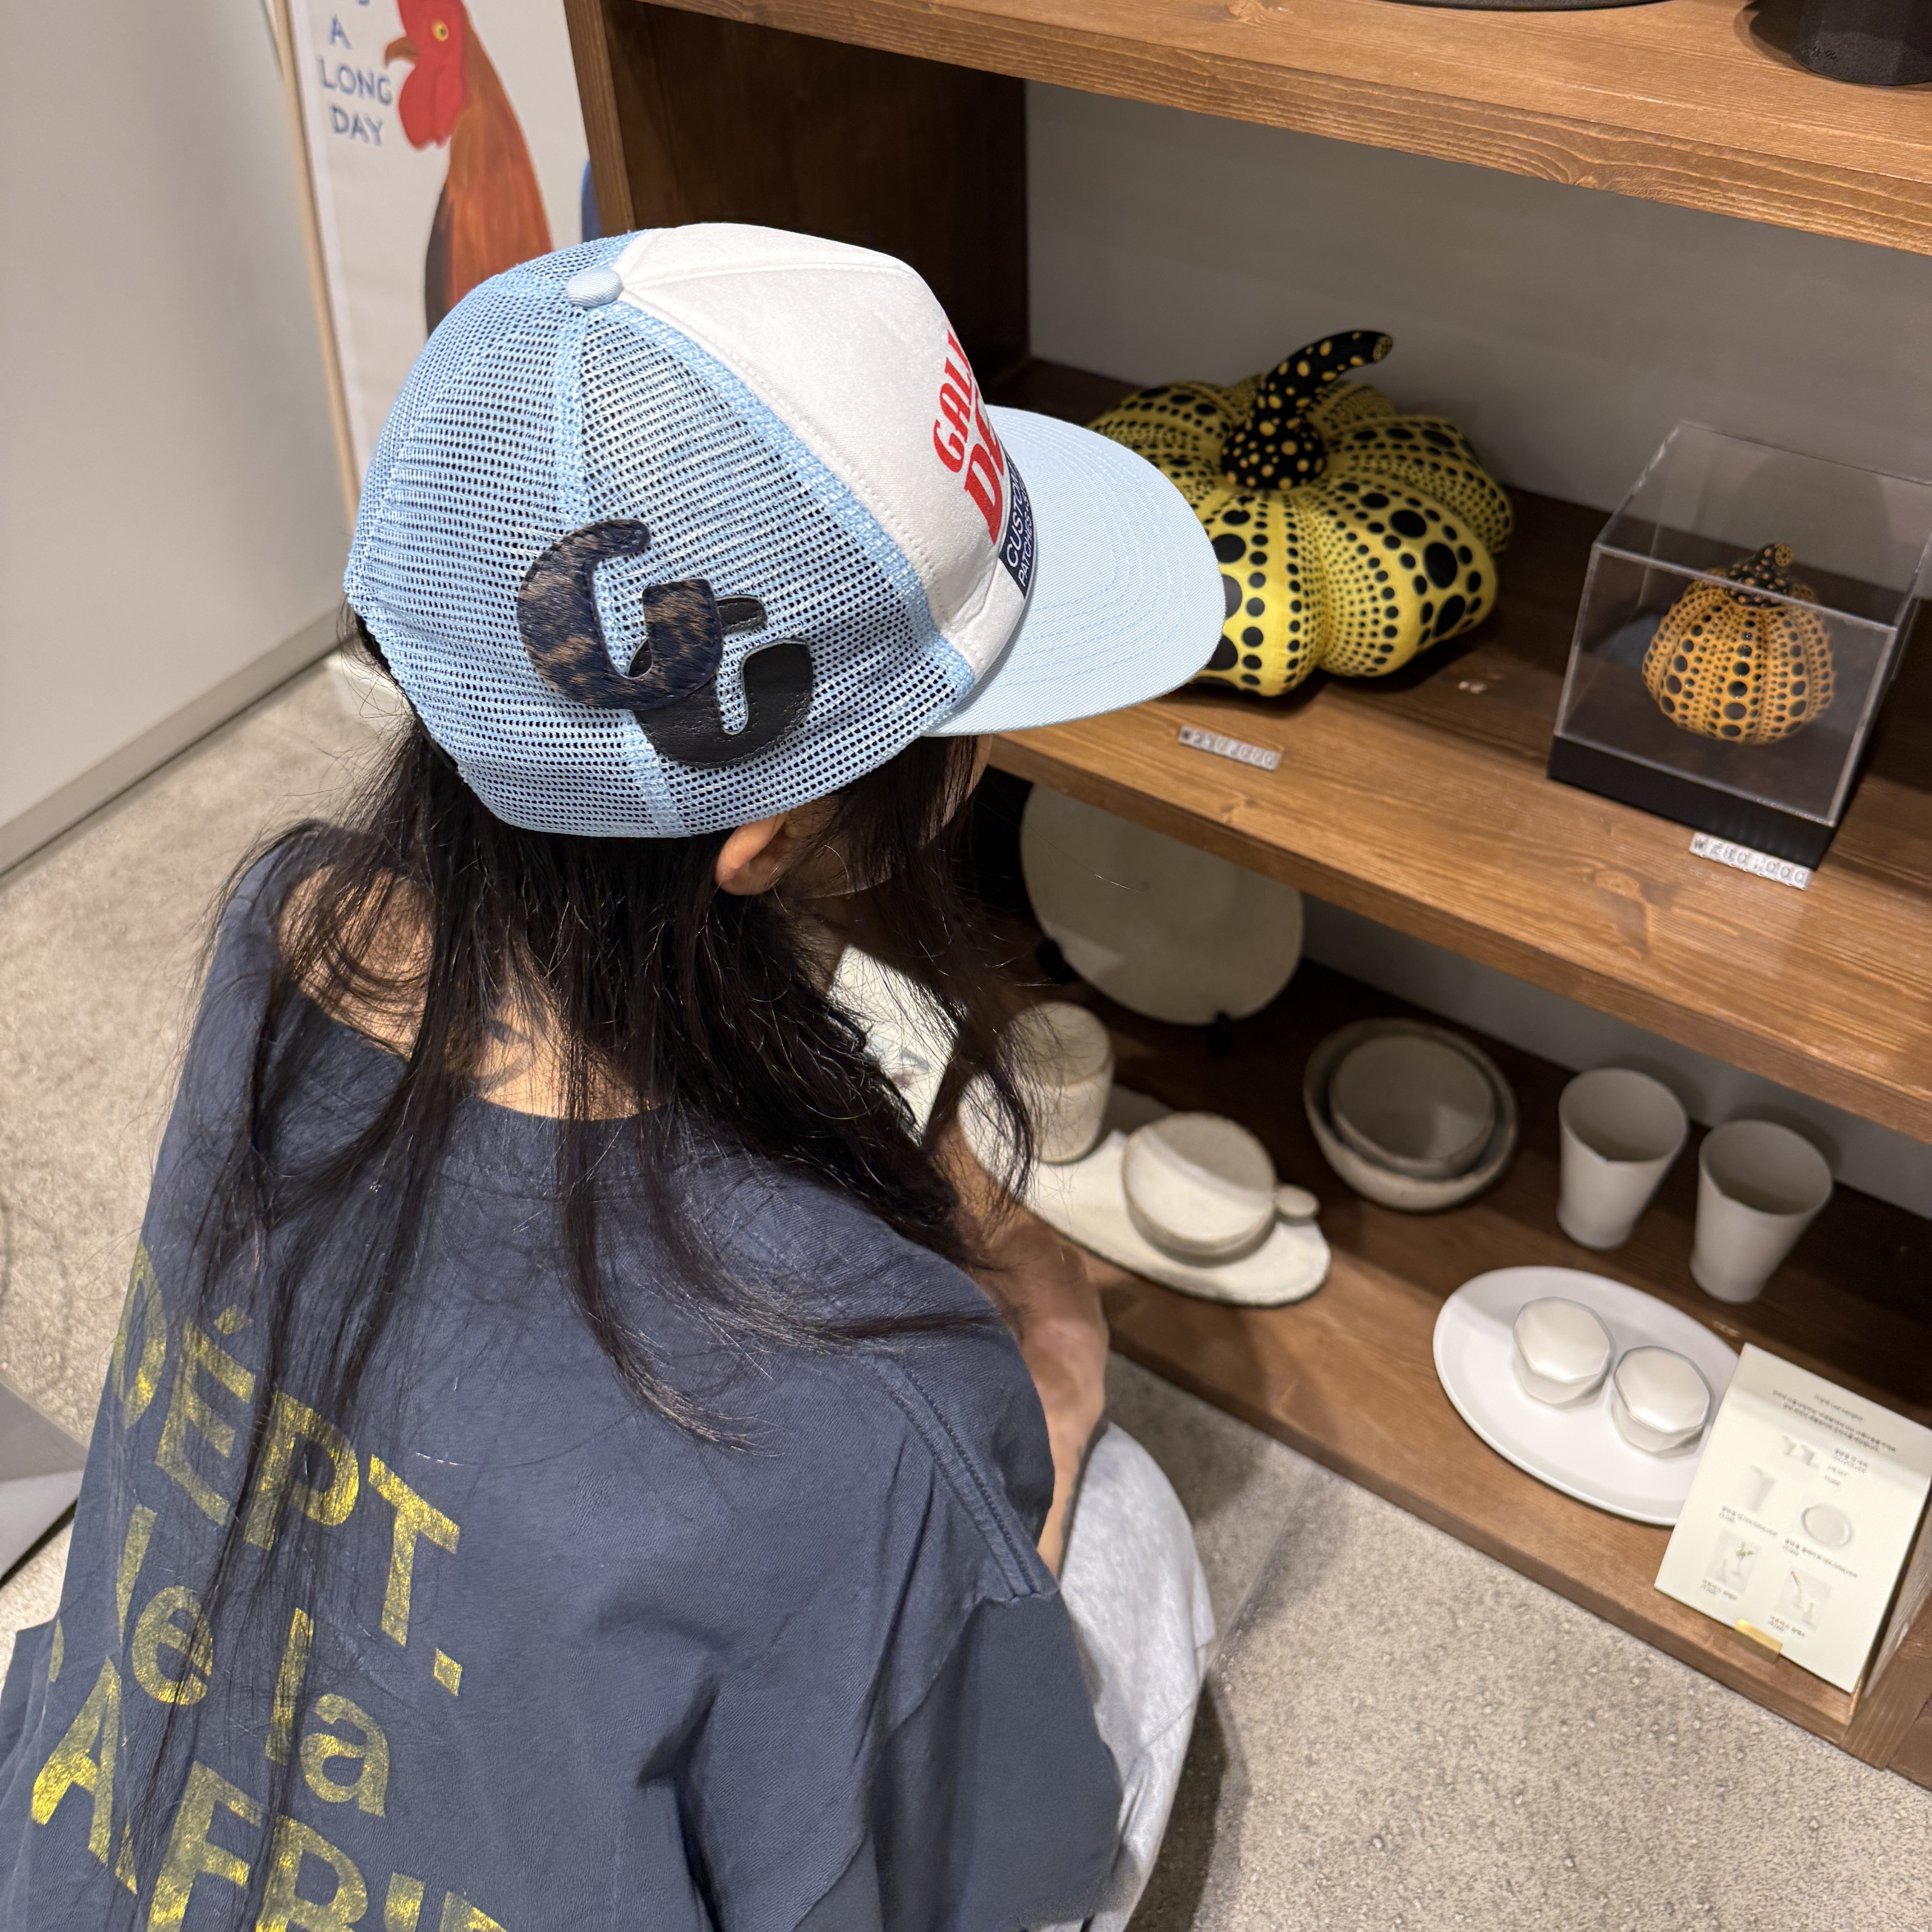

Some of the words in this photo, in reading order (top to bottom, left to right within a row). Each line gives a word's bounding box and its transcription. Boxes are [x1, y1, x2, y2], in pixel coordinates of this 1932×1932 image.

[330, 14, 352, 50] A
[318, 58, 392, 106] LONG
[330, 106, 383, 145] DAY
